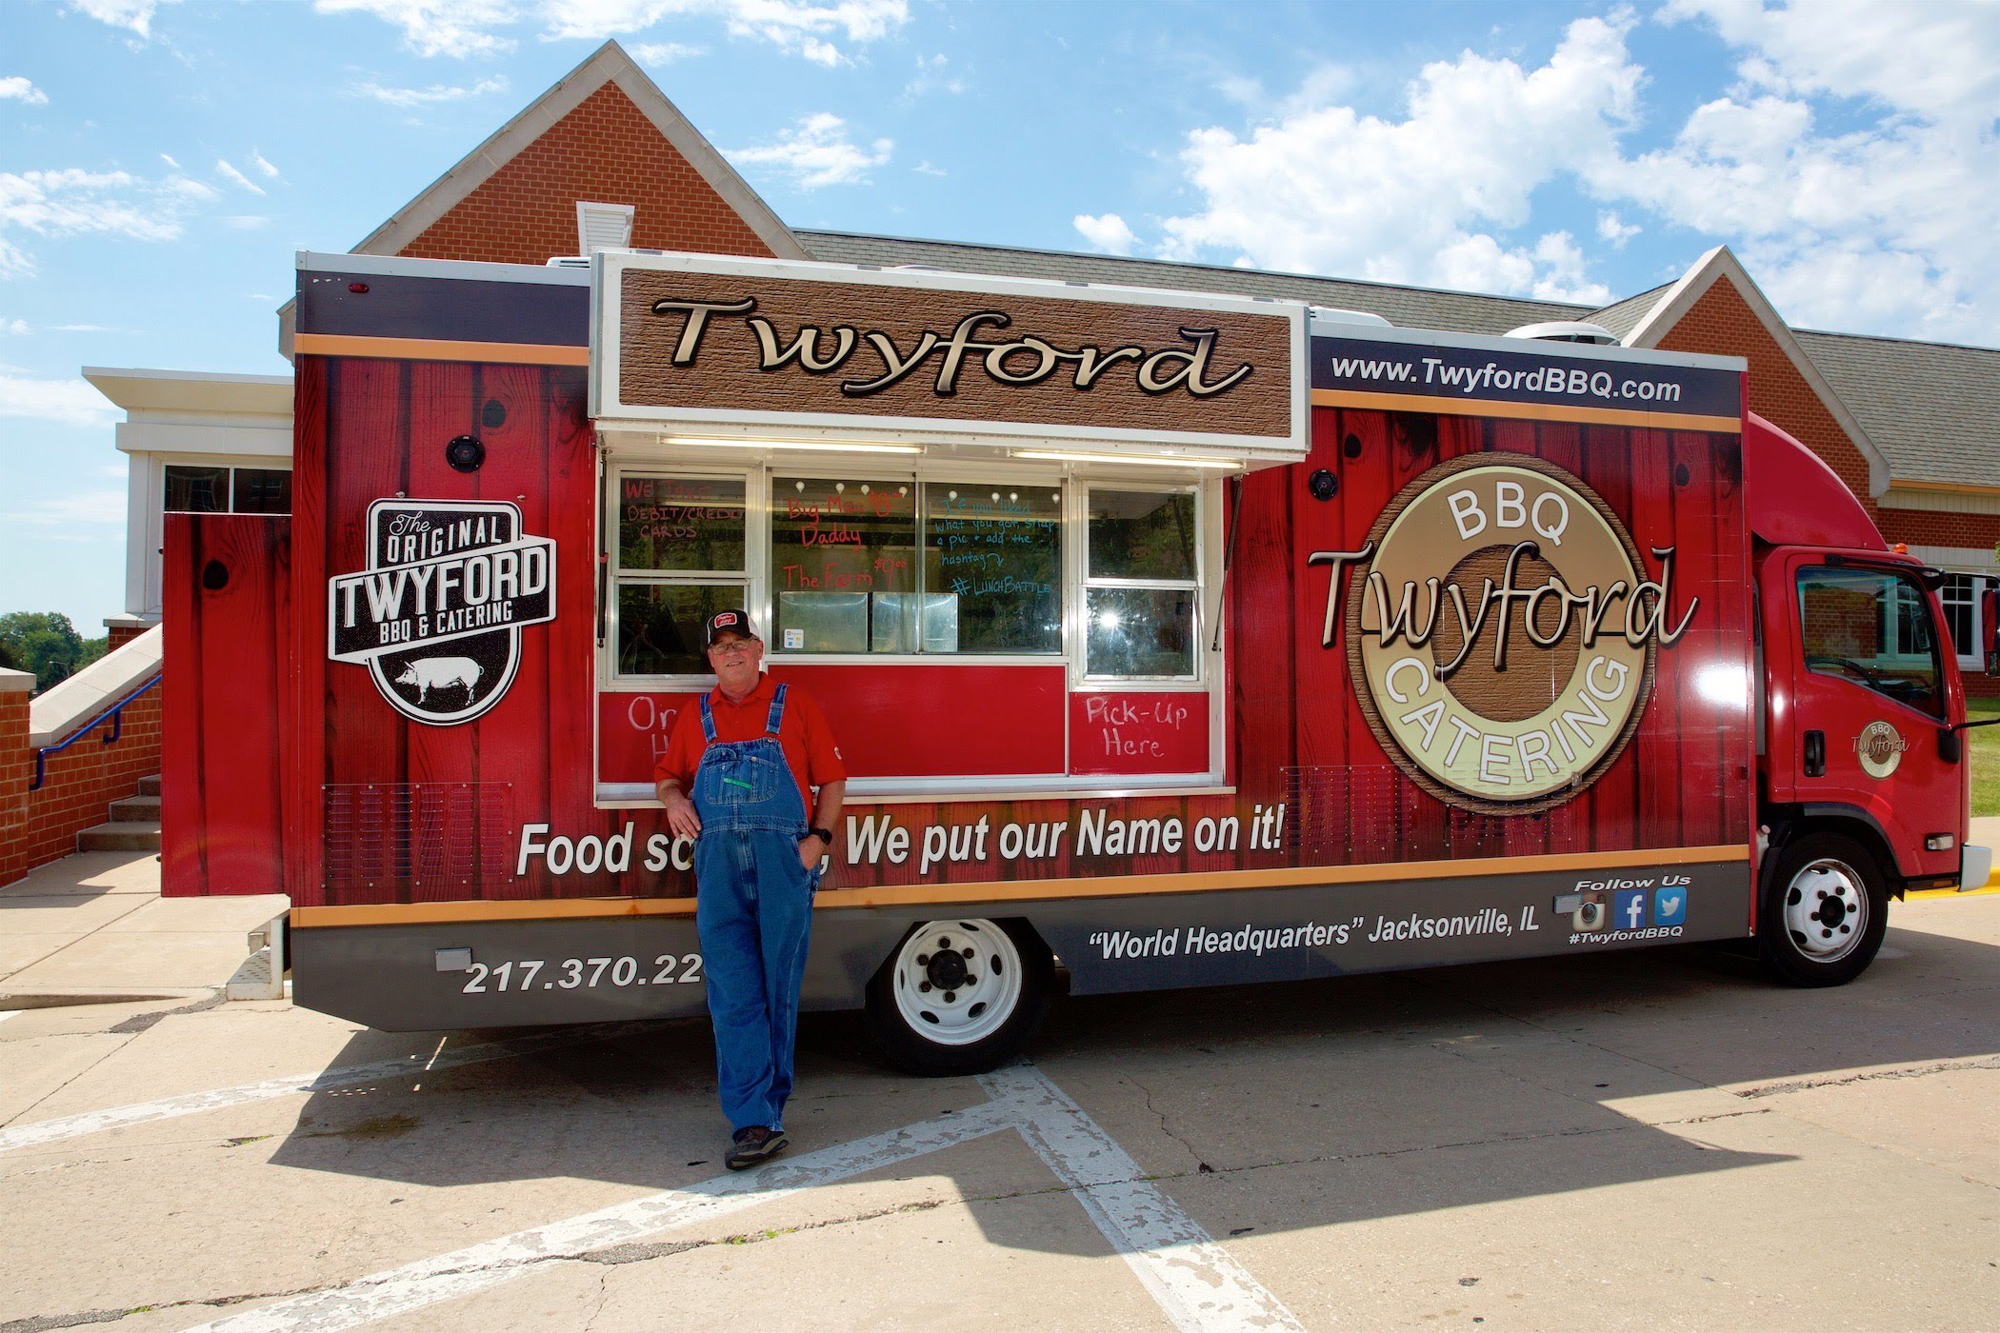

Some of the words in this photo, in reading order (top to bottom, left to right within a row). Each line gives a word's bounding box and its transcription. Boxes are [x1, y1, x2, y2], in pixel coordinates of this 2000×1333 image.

[652, 296, 1253, 398] Twyford
[1331, 357, 1681, 401] www.TwyfordBBQ.com
[389, 511, 431, 535] The
[787, 496, 819, 526] Big
[935, 518, 965, 532] what
[972, 519, 993, 532] you
[1024, 518, 1054, 533] snap
[1447, 481, 1569, 546] BBQ
[387, 516, 502, 562] ORIGINAL
[640, 525, 697, 538] CARDS
[801, 522, 861, 551] Daddy
[937, 537, 943, 546] a
[949, 533, 968, 551] pic
[986, 531, 1004, 545] add
[1011, 533, 1033, 544] the
[782, 563, 819, 588] The
[824, 562, 873, 588] Farm
[941, 551, 986, 570] hashtag
[337, 546, 547, 628] TWYFORD
[380, 619, 411, 644] BBQ
[418, 615, 429, 637] &
[437, 601, 513, 634] CATERING
[1307, 541, 1700, 682] Twyford
[1086, 696, 1187, 730] Pick-Up
[1385, 655, 1630, 785] CATERING
[1103, 728, 1165, 757] Here
[516, 821, 635, 875] Food
[846, 814, 910, 864] We
[920, 813, 989, 875] put
[999, 821, 1068, 860] our
[1076, 809, 1183, 856] Name
[1194, 815, 1239, 852] on
[1249, 803, 1286, 853] it!
[1574, 878, 1655, 892] Follow
[1661, 875, 1692, 887] Us
[1368, 907, 1512, 943] Jacksonville,
[1519, 905, 1540, 932] IL
[1569, 926, 1683, 945] #TwyfordBBQ
[462, 953, 703, 994] 217.370.22
